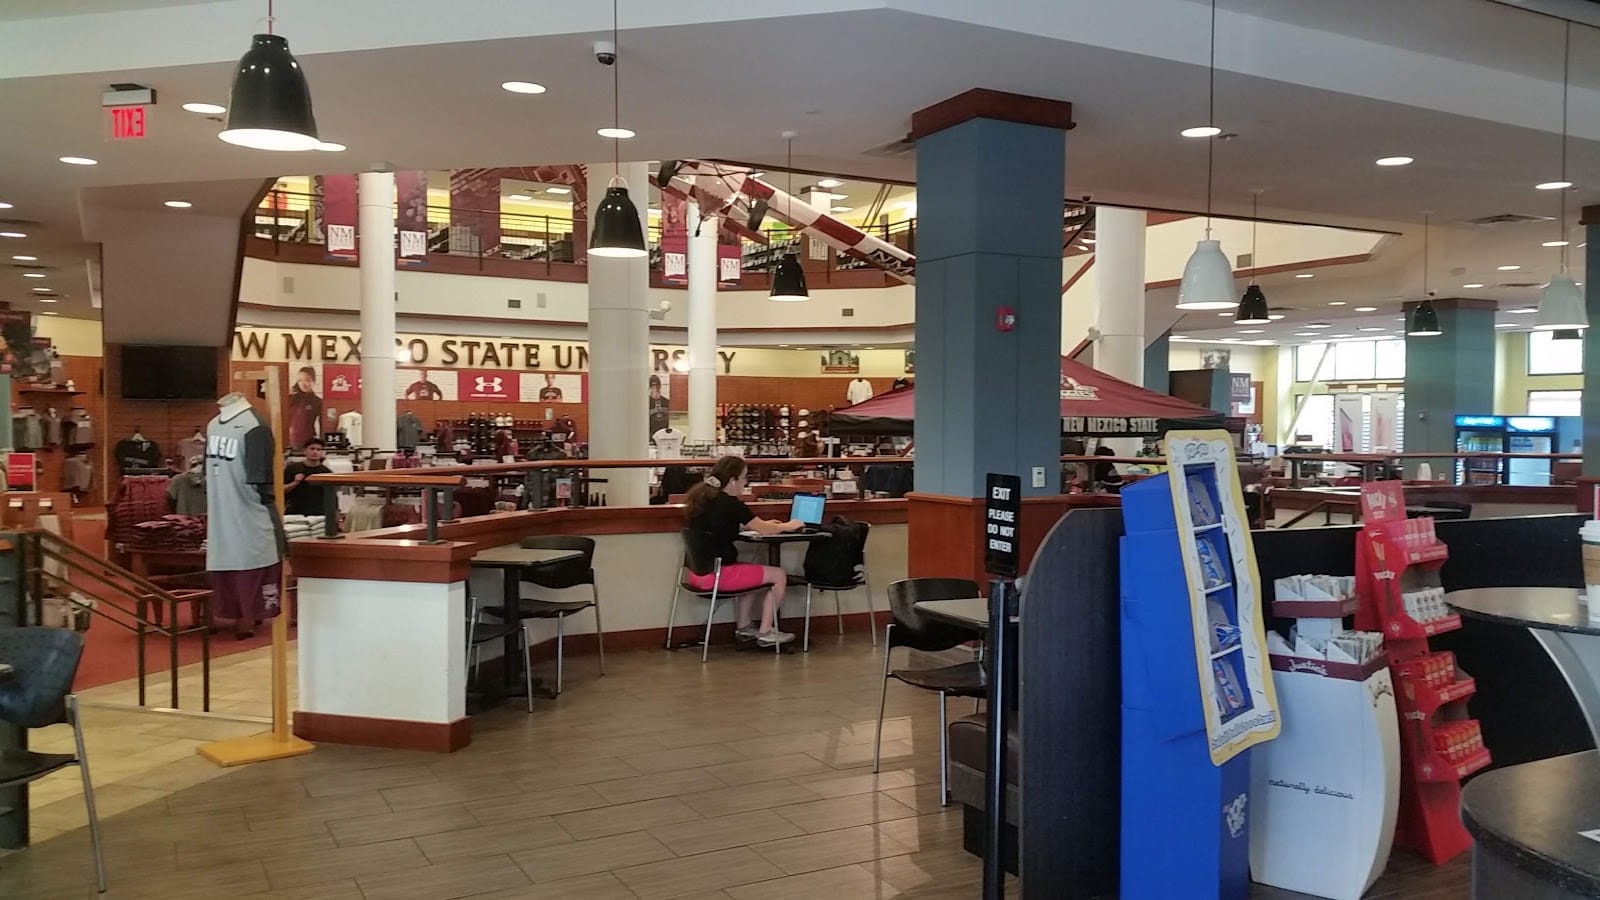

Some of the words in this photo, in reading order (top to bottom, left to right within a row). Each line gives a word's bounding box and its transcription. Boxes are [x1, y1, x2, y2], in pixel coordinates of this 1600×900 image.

[282, 333, 429, 365] MEXO
[441, 340, 540, 368] STATE
[1231, 376, 1250, 388] NM
[1062, 417, 1085, 433] NEW
[1087, 417, 1128, 433] MEXICO
[1129, 417, 1160, 433] STATE
[207, 435, 239, 460] MSU
[992, 486, 1012, 501] EXIT
[988, 508, 1015, 523] PLEASE
[987, 523, 999, 535] DO
[999, 525, 1015, 538] NOT
[989, 538, 1012, 553] ENTER
